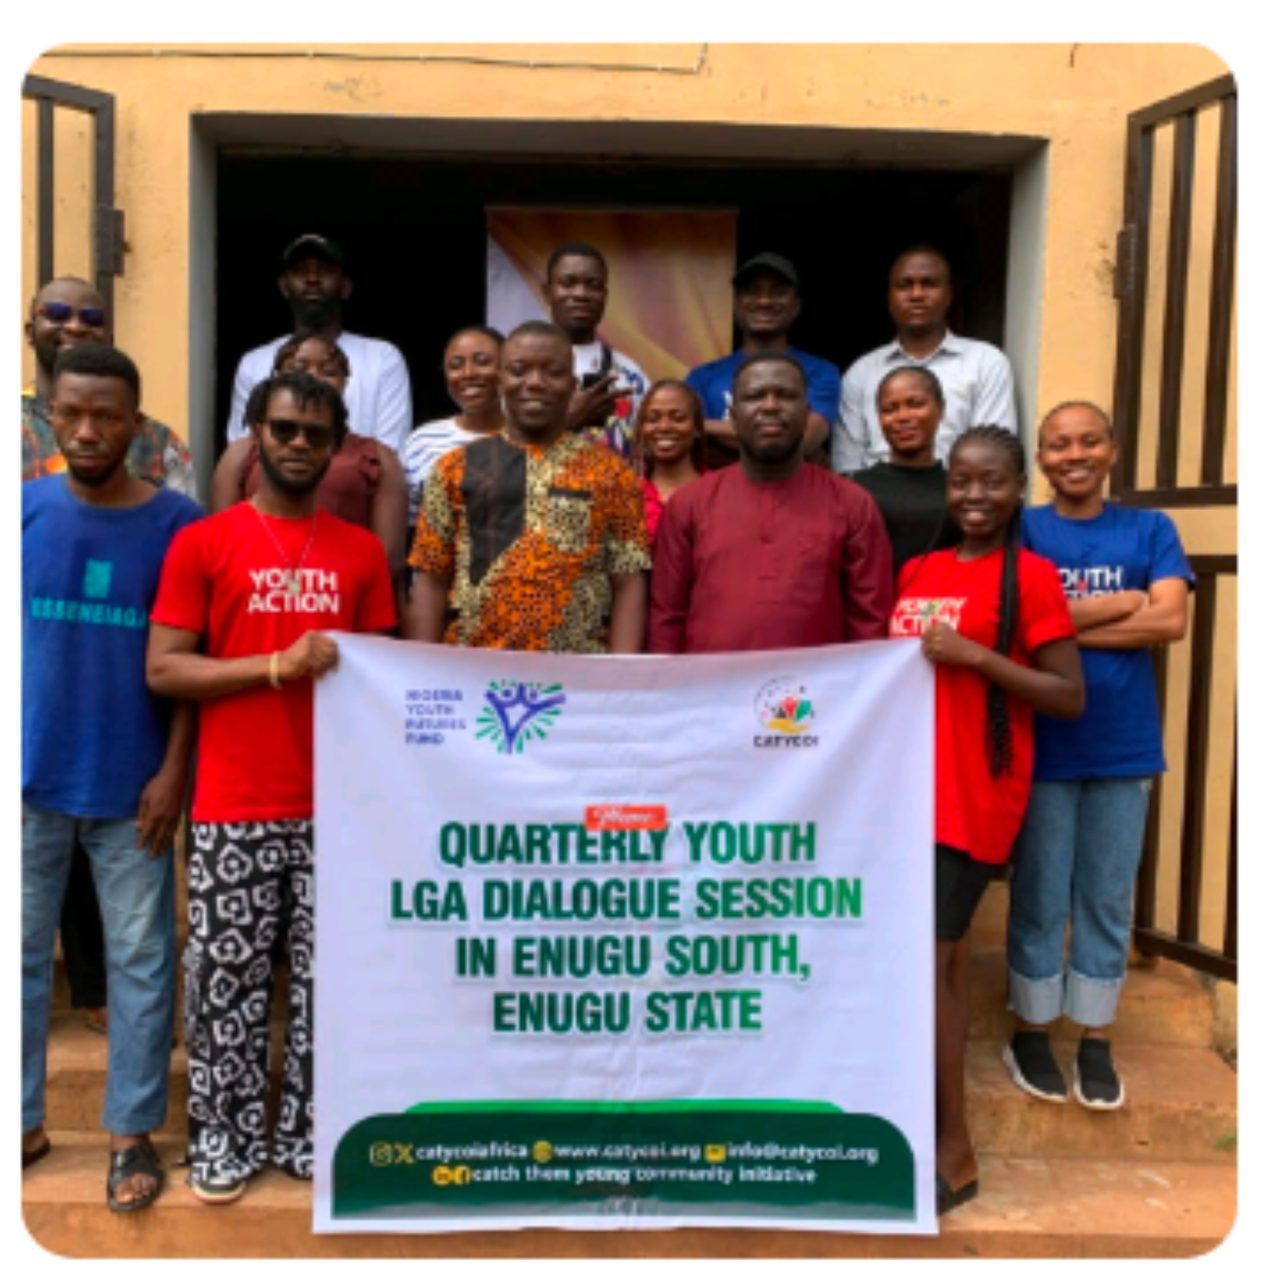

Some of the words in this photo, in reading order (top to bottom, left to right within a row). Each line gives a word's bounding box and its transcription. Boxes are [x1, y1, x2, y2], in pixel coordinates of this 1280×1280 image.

[248, 567, 338, 591] YOUTH
[1058, 565, 1122, 588] OUTH
[248, 593, 340, 614] ACTION
[439, 821, 668, 865] QUARTERLY
[684, 820, 817, 862] YOUTH
[391, 879, 468, 922] LGA
[483, 879, 681, 921] DIALOGUE
[695, 877, 863, 919] SESSION
[455, 936, 496, 977] IN
[512, 935, 651, 977] ENUGU
[665, 934, 811, 981] SOUTH,
[493, 992, 630, 1033] ENUGU
[646, 989, 762, 1031] STATE
[473, 1165, 520, 1182] catch
[525, 1165, 570, 1181] them
[575, 1168, 630, 1186] young
[635, 1165, 733, 1185] community
[738, 1165, 817, 1182] initiative
